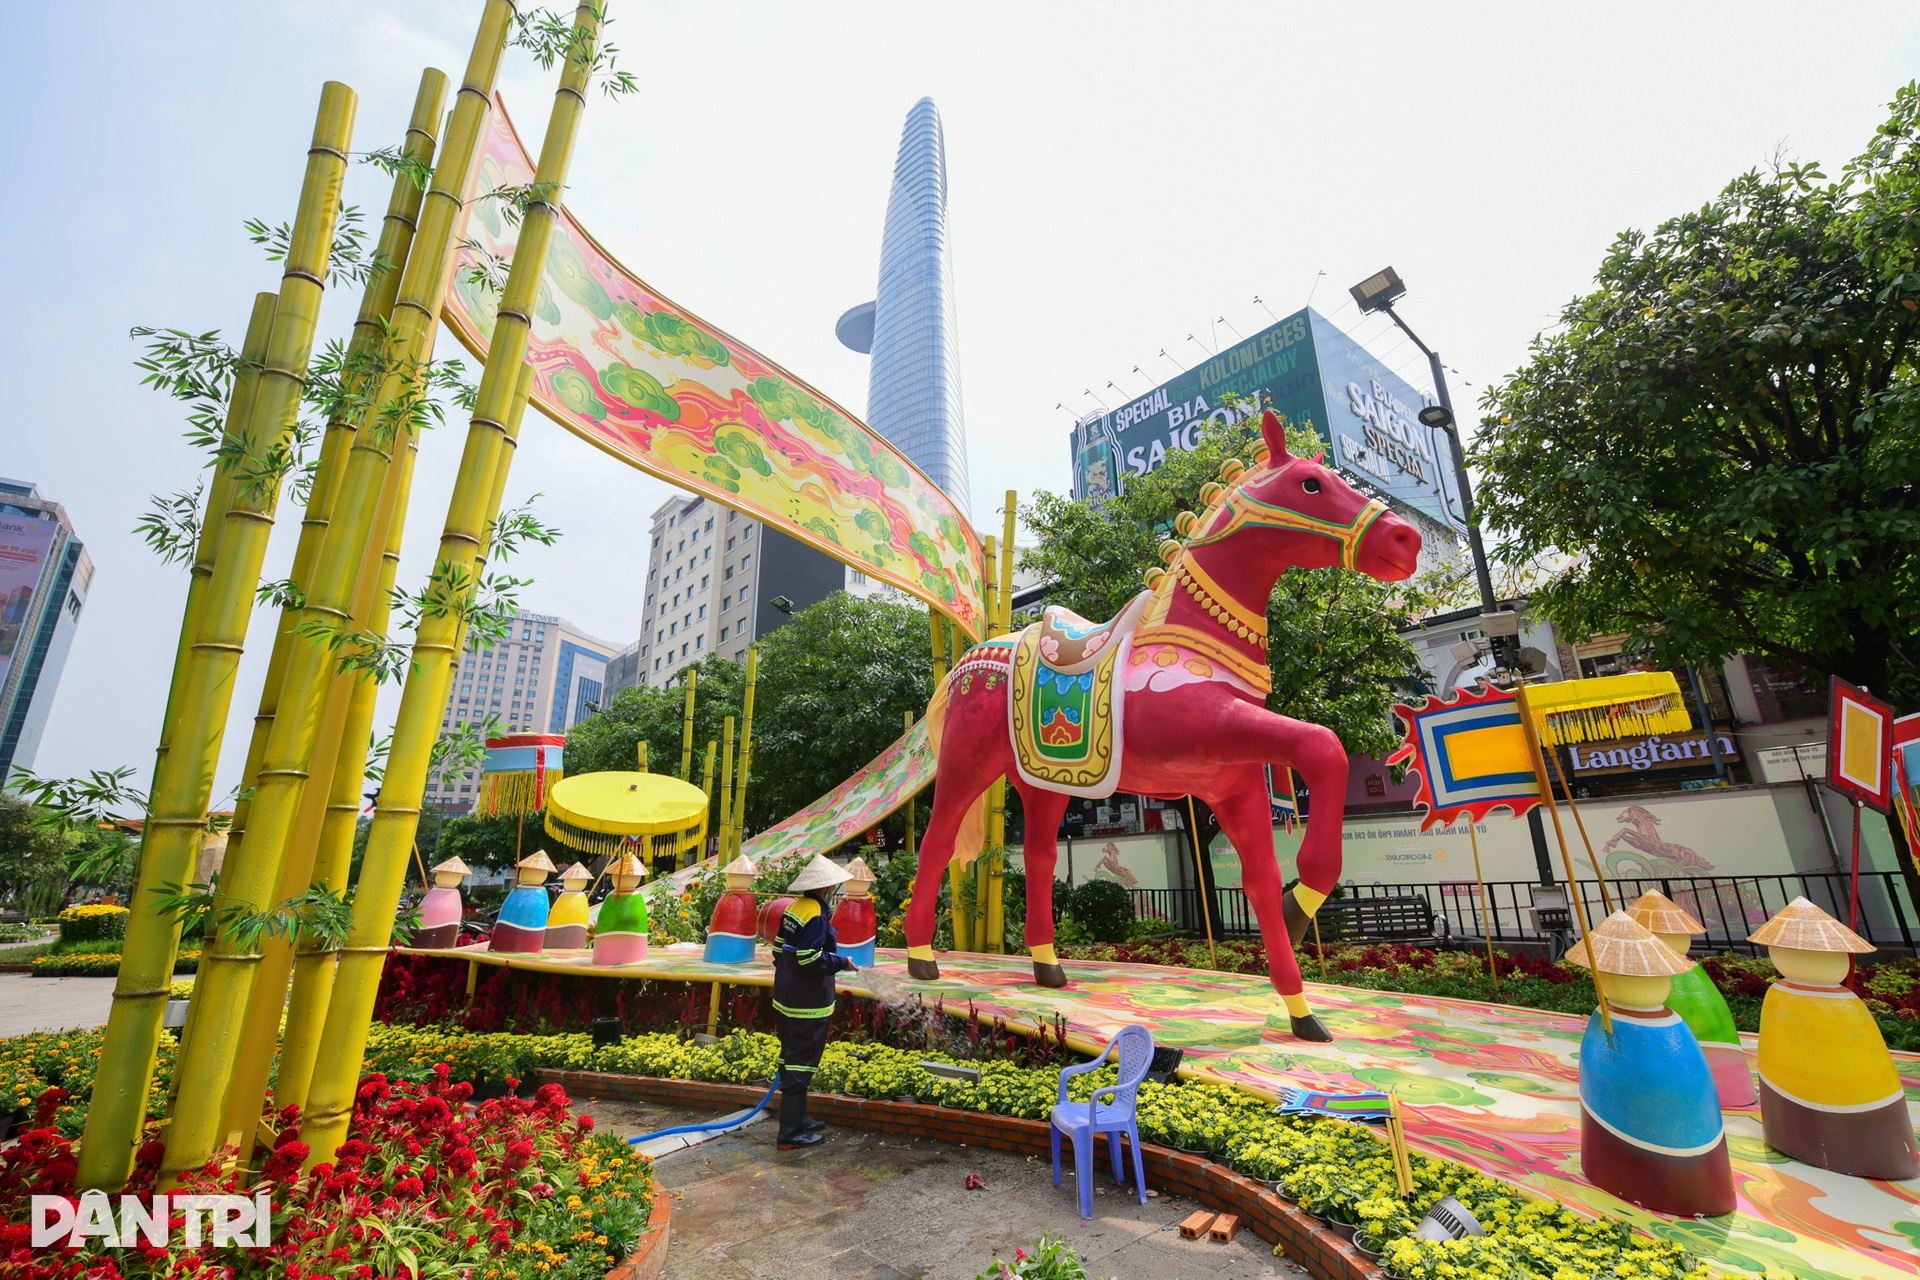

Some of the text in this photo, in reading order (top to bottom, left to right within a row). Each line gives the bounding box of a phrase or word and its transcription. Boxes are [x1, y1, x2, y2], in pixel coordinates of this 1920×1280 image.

[1199, 317, 1306, 390] KÜLÖNLEGES
[1115, 388, 1172, 432] ŠPECIÁL
[1167, 395, 1210, 430] BIA
[1370, 380, 1398, 414] BIA
[1346, 382, 1433, 464] SAIGON
[0, 522, 25, 533] ank
[531, 613, 559, 623] TOWER
[1568, 735, 1737, 771] Langfarm
